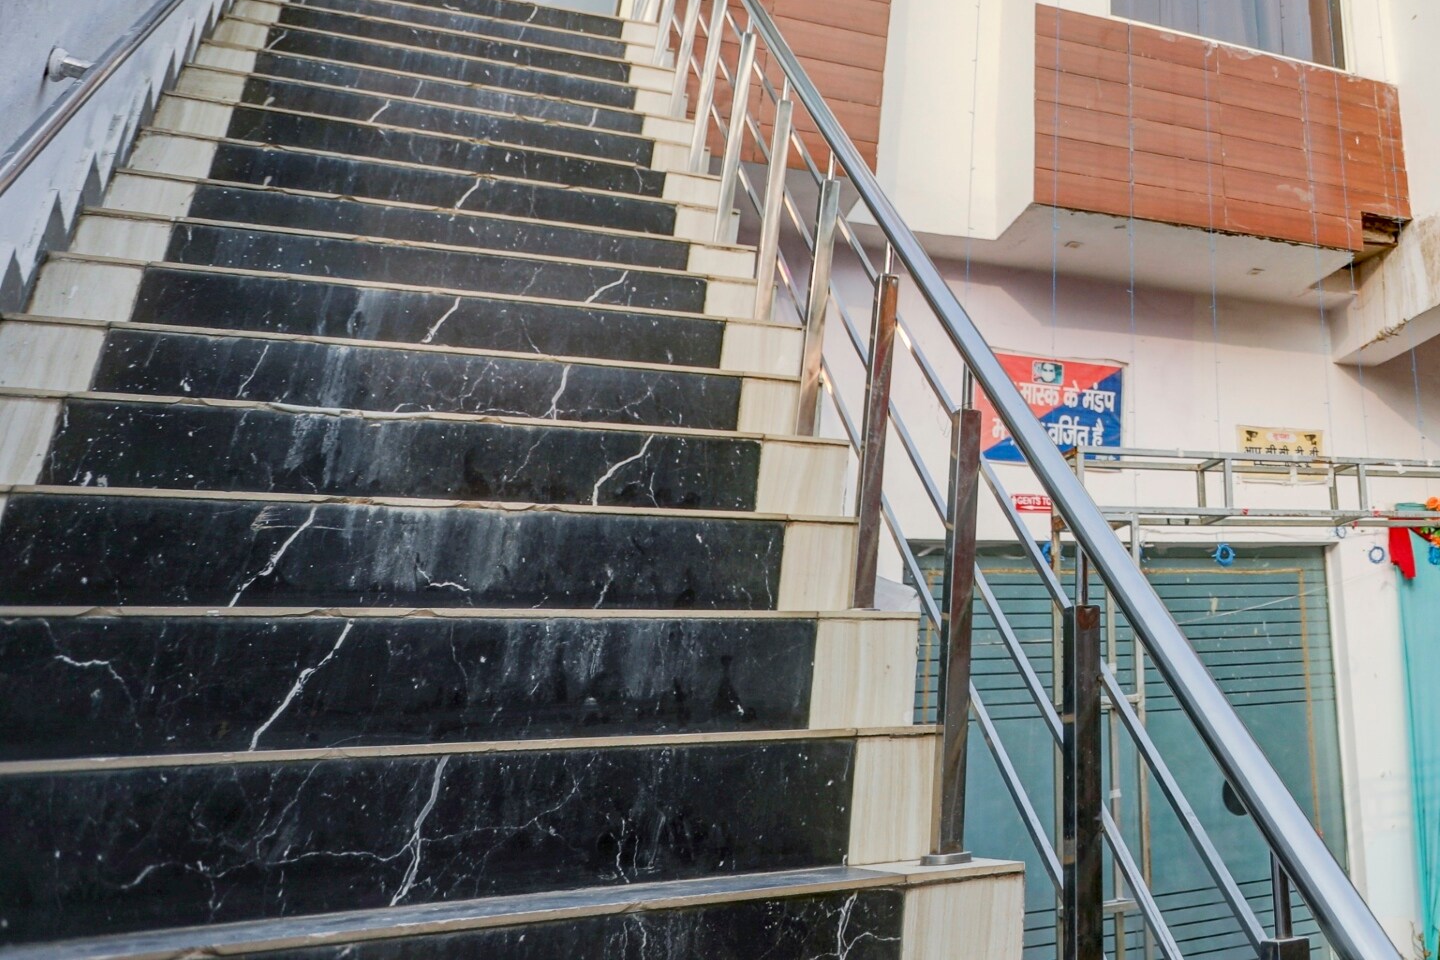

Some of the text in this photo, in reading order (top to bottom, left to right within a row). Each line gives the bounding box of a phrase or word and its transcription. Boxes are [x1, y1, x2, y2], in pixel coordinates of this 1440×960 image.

[1063, 380, 1080, 408] के
[1082, 382, 1116, 413] मंडप
[1017, 496, 1041, 506] GENTS
